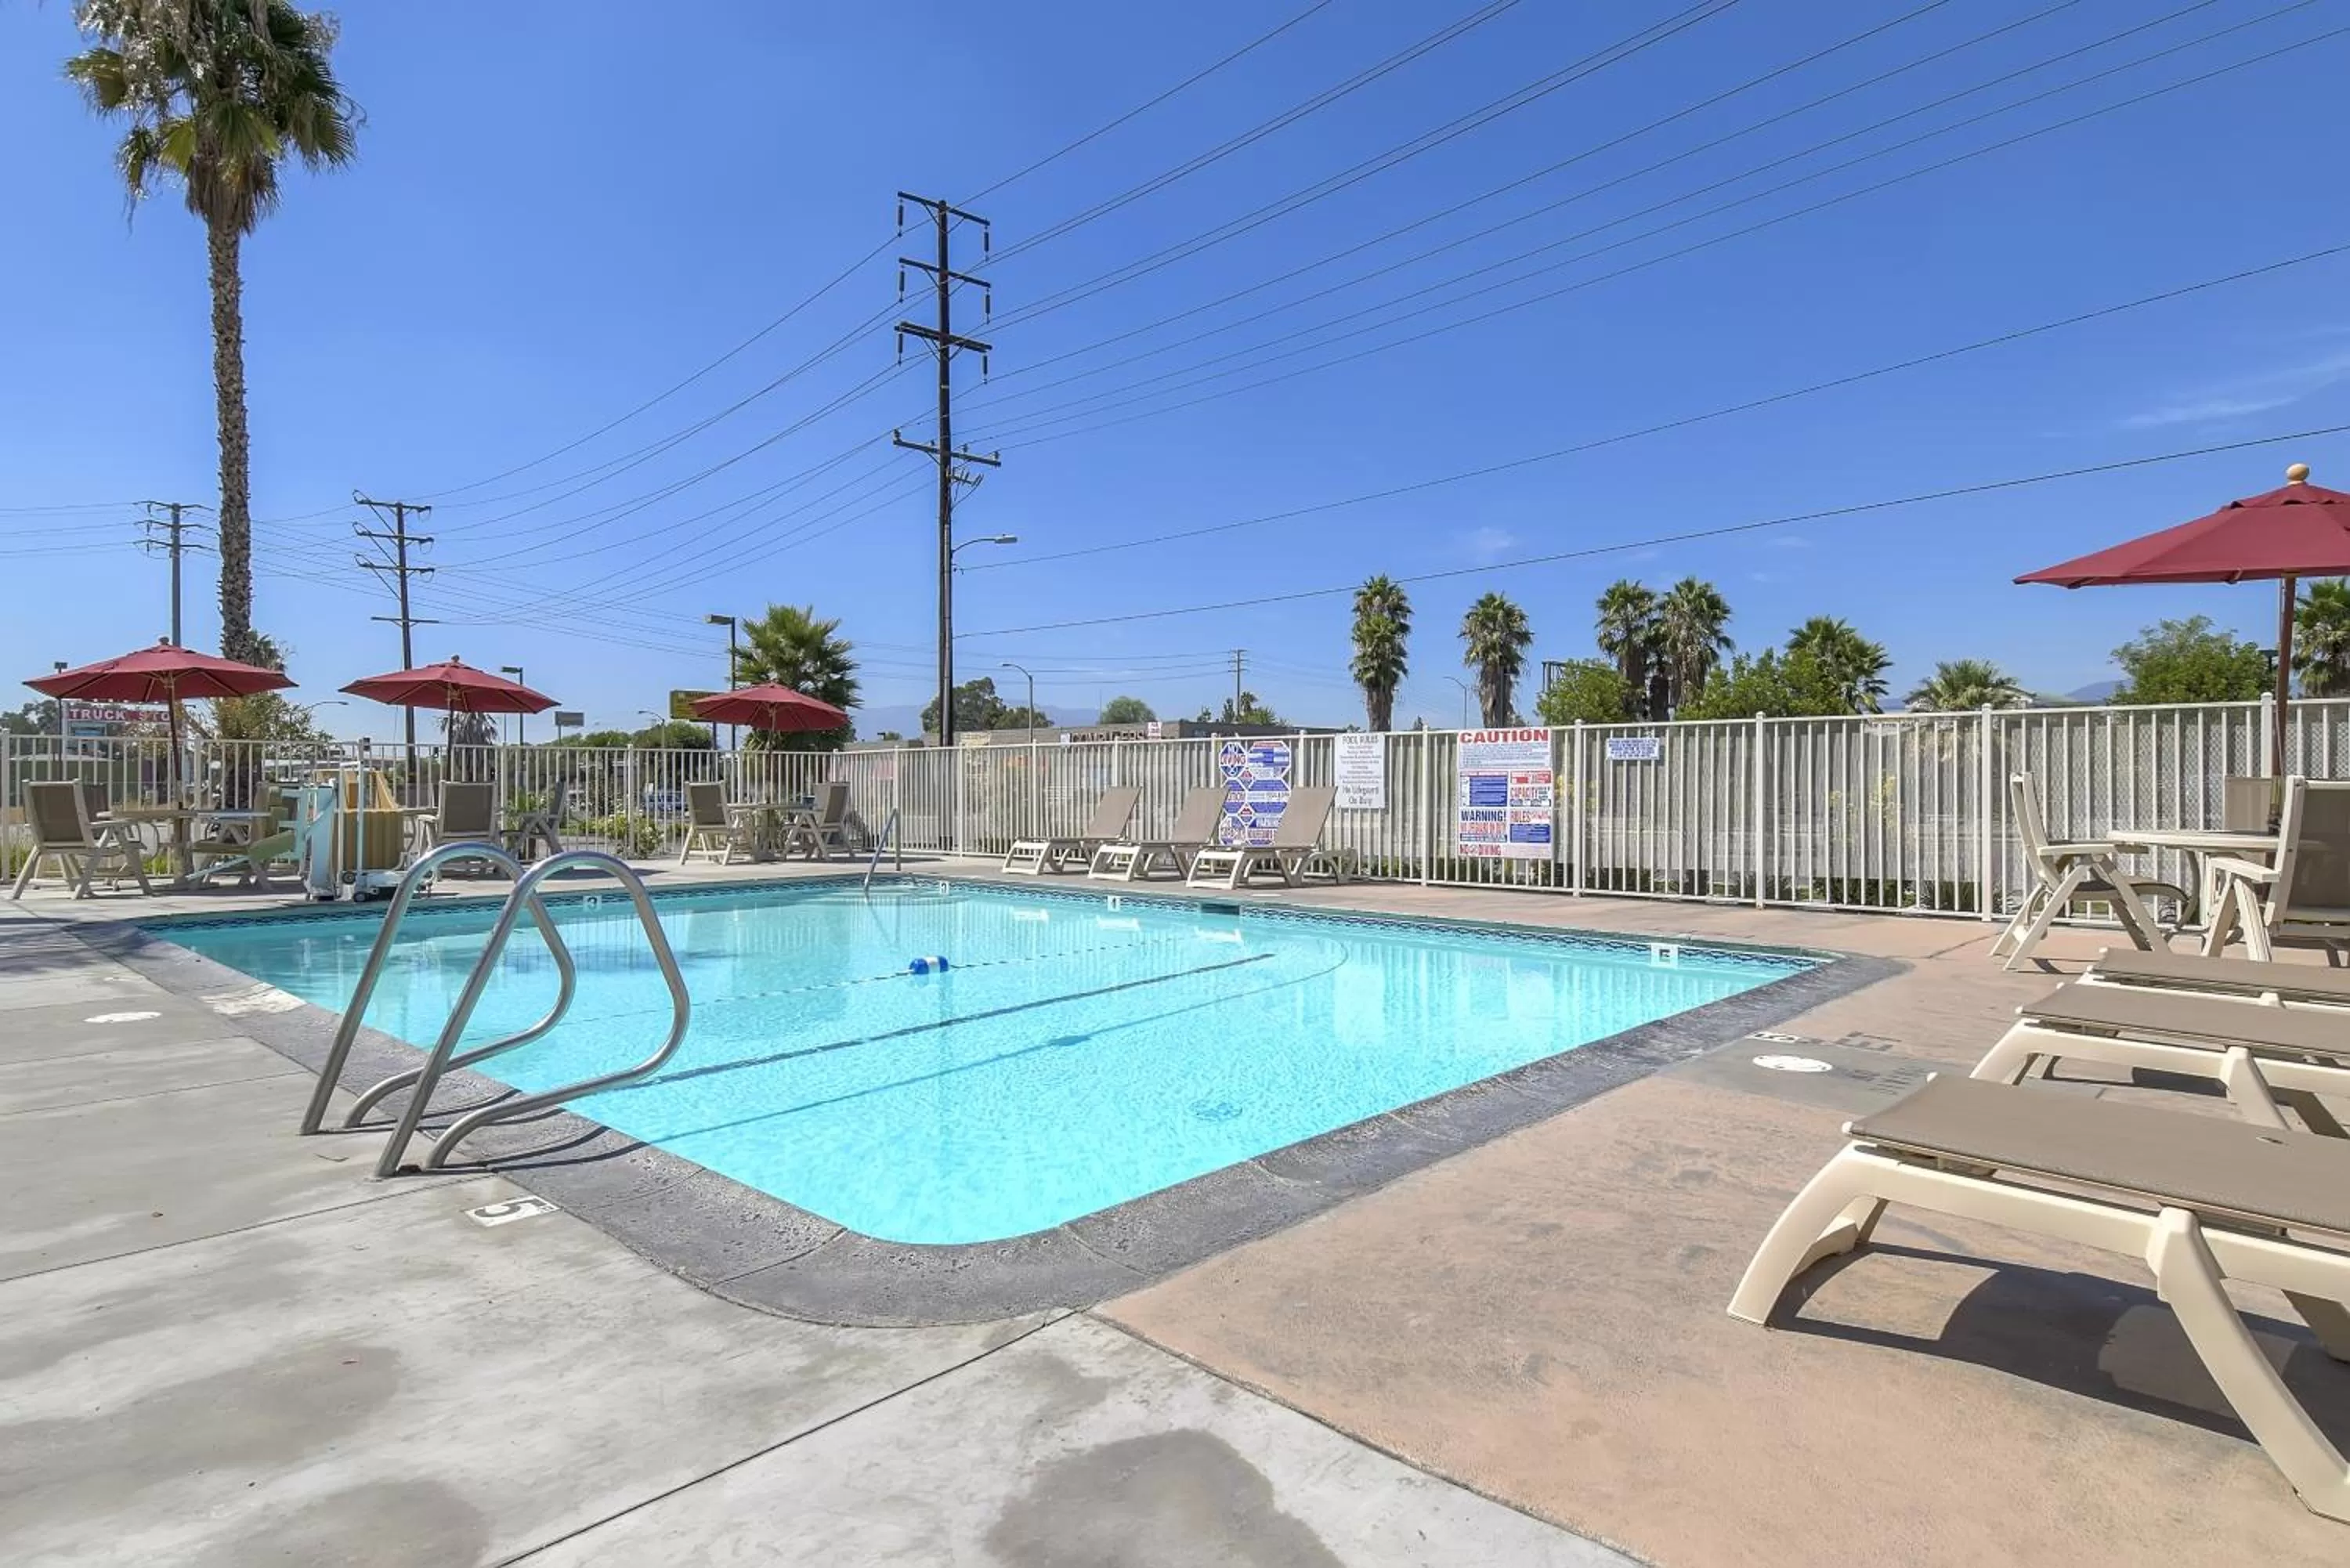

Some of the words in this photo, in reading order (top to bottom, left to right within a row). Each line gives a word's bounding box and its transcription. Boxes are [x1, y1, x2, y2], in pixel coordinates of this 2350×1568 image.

[70, 708, 126, 720] TRUCK
[139, 710, 171, 721] STO
[1459, 729, 1549, 743] CAUTION
[1220, 753, 1246, 766] DIVING
[1461, 811, 1506, 822] WARNING!
[474, 1199, 548, 1217] 5
